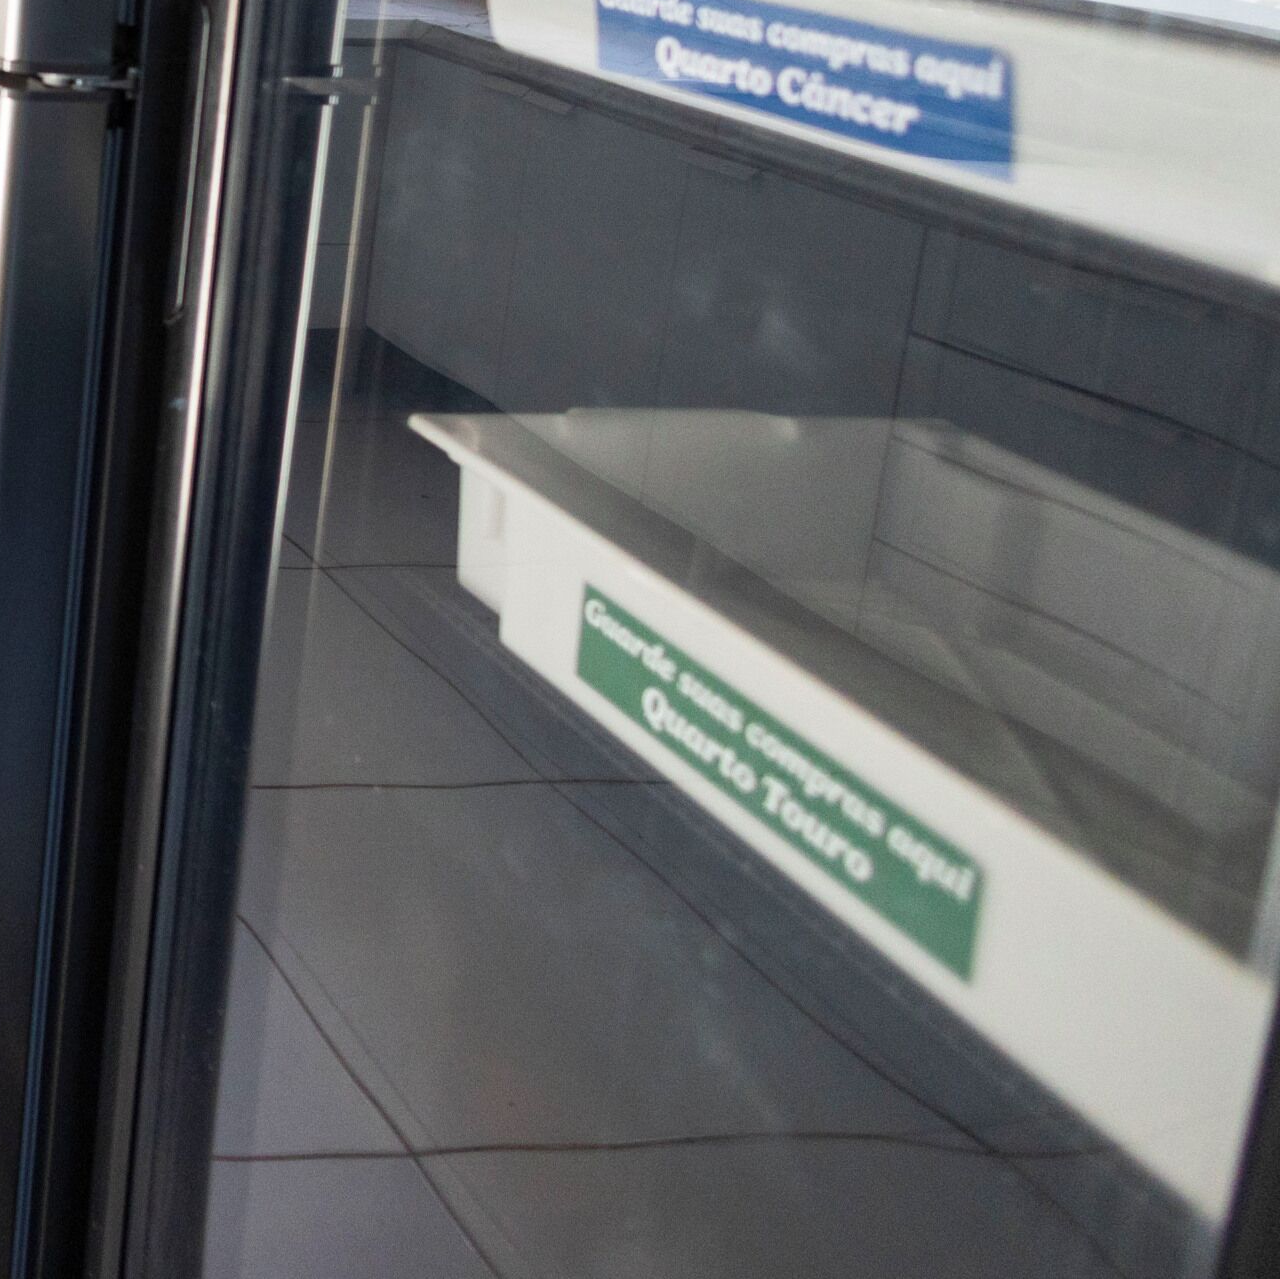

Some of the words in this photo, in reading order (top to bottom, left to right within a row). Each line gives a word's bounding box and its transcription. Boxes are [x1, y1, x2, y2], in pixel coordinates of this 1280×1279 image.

[654, 36, 774, 99] Quarto
[696, 4, 764, 44] suas
[766, 20, 912, 79] compras
[915, 51, 1005, 99] aqui
[583, 598, 677, 683] Guarde
[677, 671, 745, 733] suas
[745, 721, 887, 837] compras
[886, 824, 976, 903] aqui
[640, 686, 757, 794] Quarto
[761, 774, 874, 882] Touro
